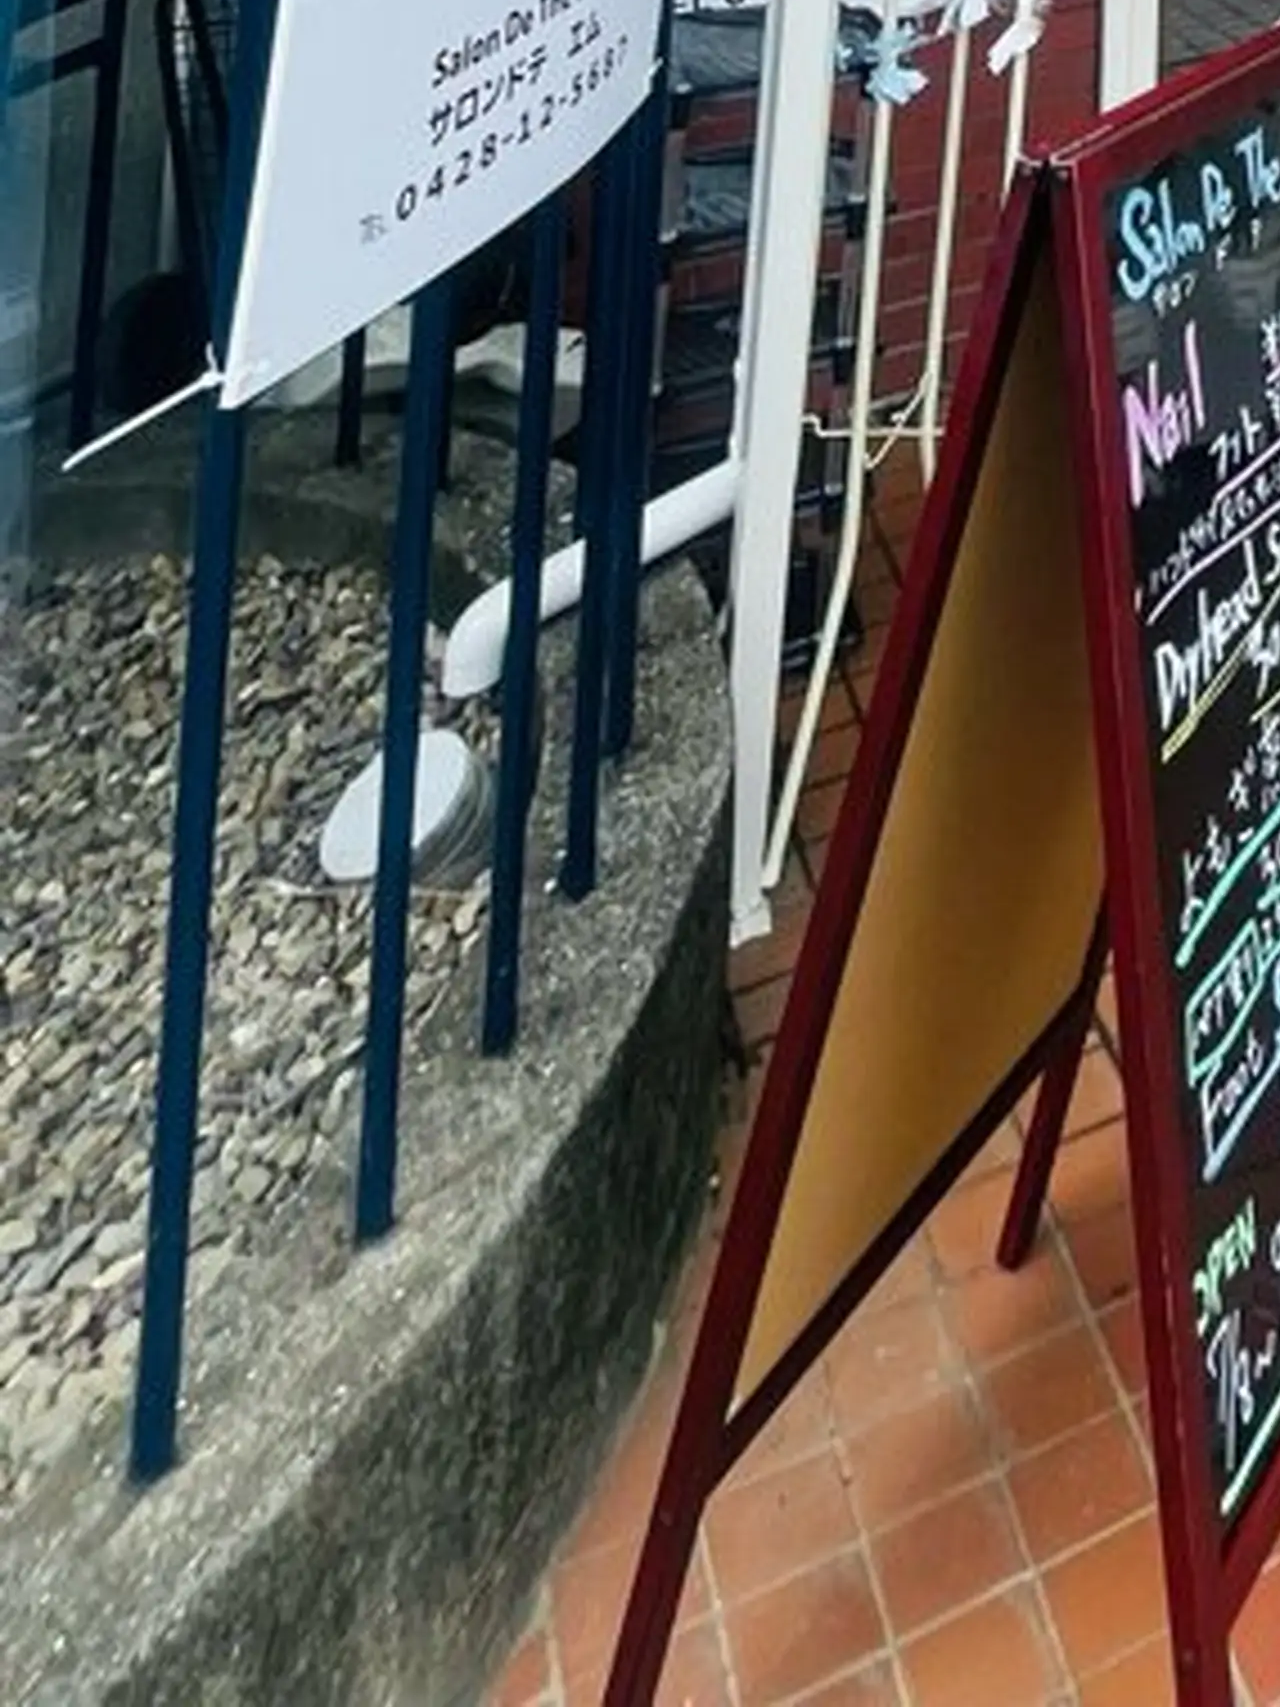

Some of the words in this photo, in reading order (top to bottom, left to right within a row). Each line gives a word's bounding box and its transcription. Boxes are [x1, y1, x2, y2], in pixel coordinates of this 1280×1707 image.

[428, 44, 548, 148] サロンドテ
[567, 11, 603, 59] エム
[431, 27, 502, 88] Salon
[505, 9, 534, 46] De
[1117, 177, 1204, 302] Salon
[1125, 318, 1206, 511] Nail
[1198, 1195, 1256, 1337] OPEN
